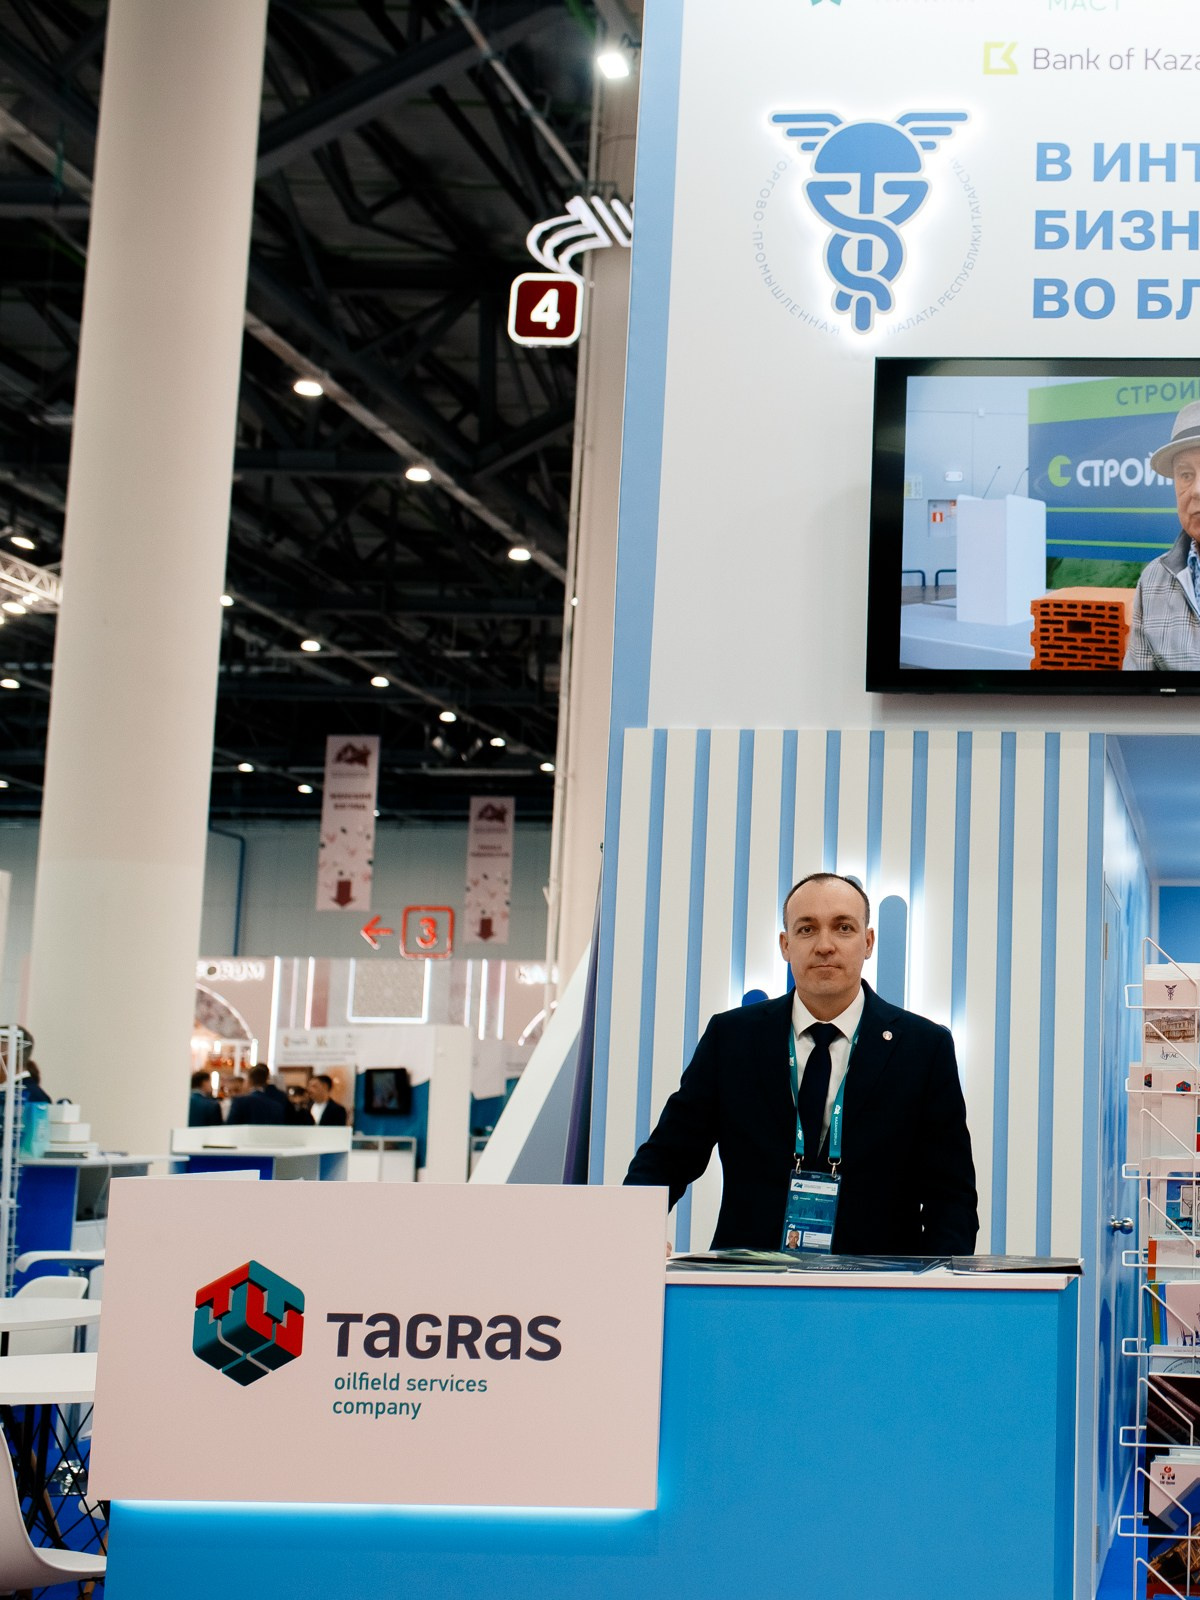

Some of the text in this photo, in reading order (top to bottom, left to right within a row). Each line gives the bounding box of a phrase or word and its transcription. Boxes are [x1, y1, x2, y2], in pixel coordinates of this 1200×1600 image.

[1033, 47, 1100, 72] Bank
[1109, 47, 1135, 72] of
[1035, 142, 1072, 182] В
[951, 158, 983, 222] ТАТАРСТА
[752, 156, 840, 335] ОРГОВО-ПРОМЫШЛЕННАЯ
[937, 225, 982, 308] РЕСПУБЛИКИ
[530, 288, 560, 330] 4
[1032, 278, 1116, 320] ВО
[1076, 452, 1175, 487] СТРОЙ
[416, 916, 438, 949] 3
[334, 1372, 488, 1392] oilfield services
[332, 1399, 421, 1420] company
